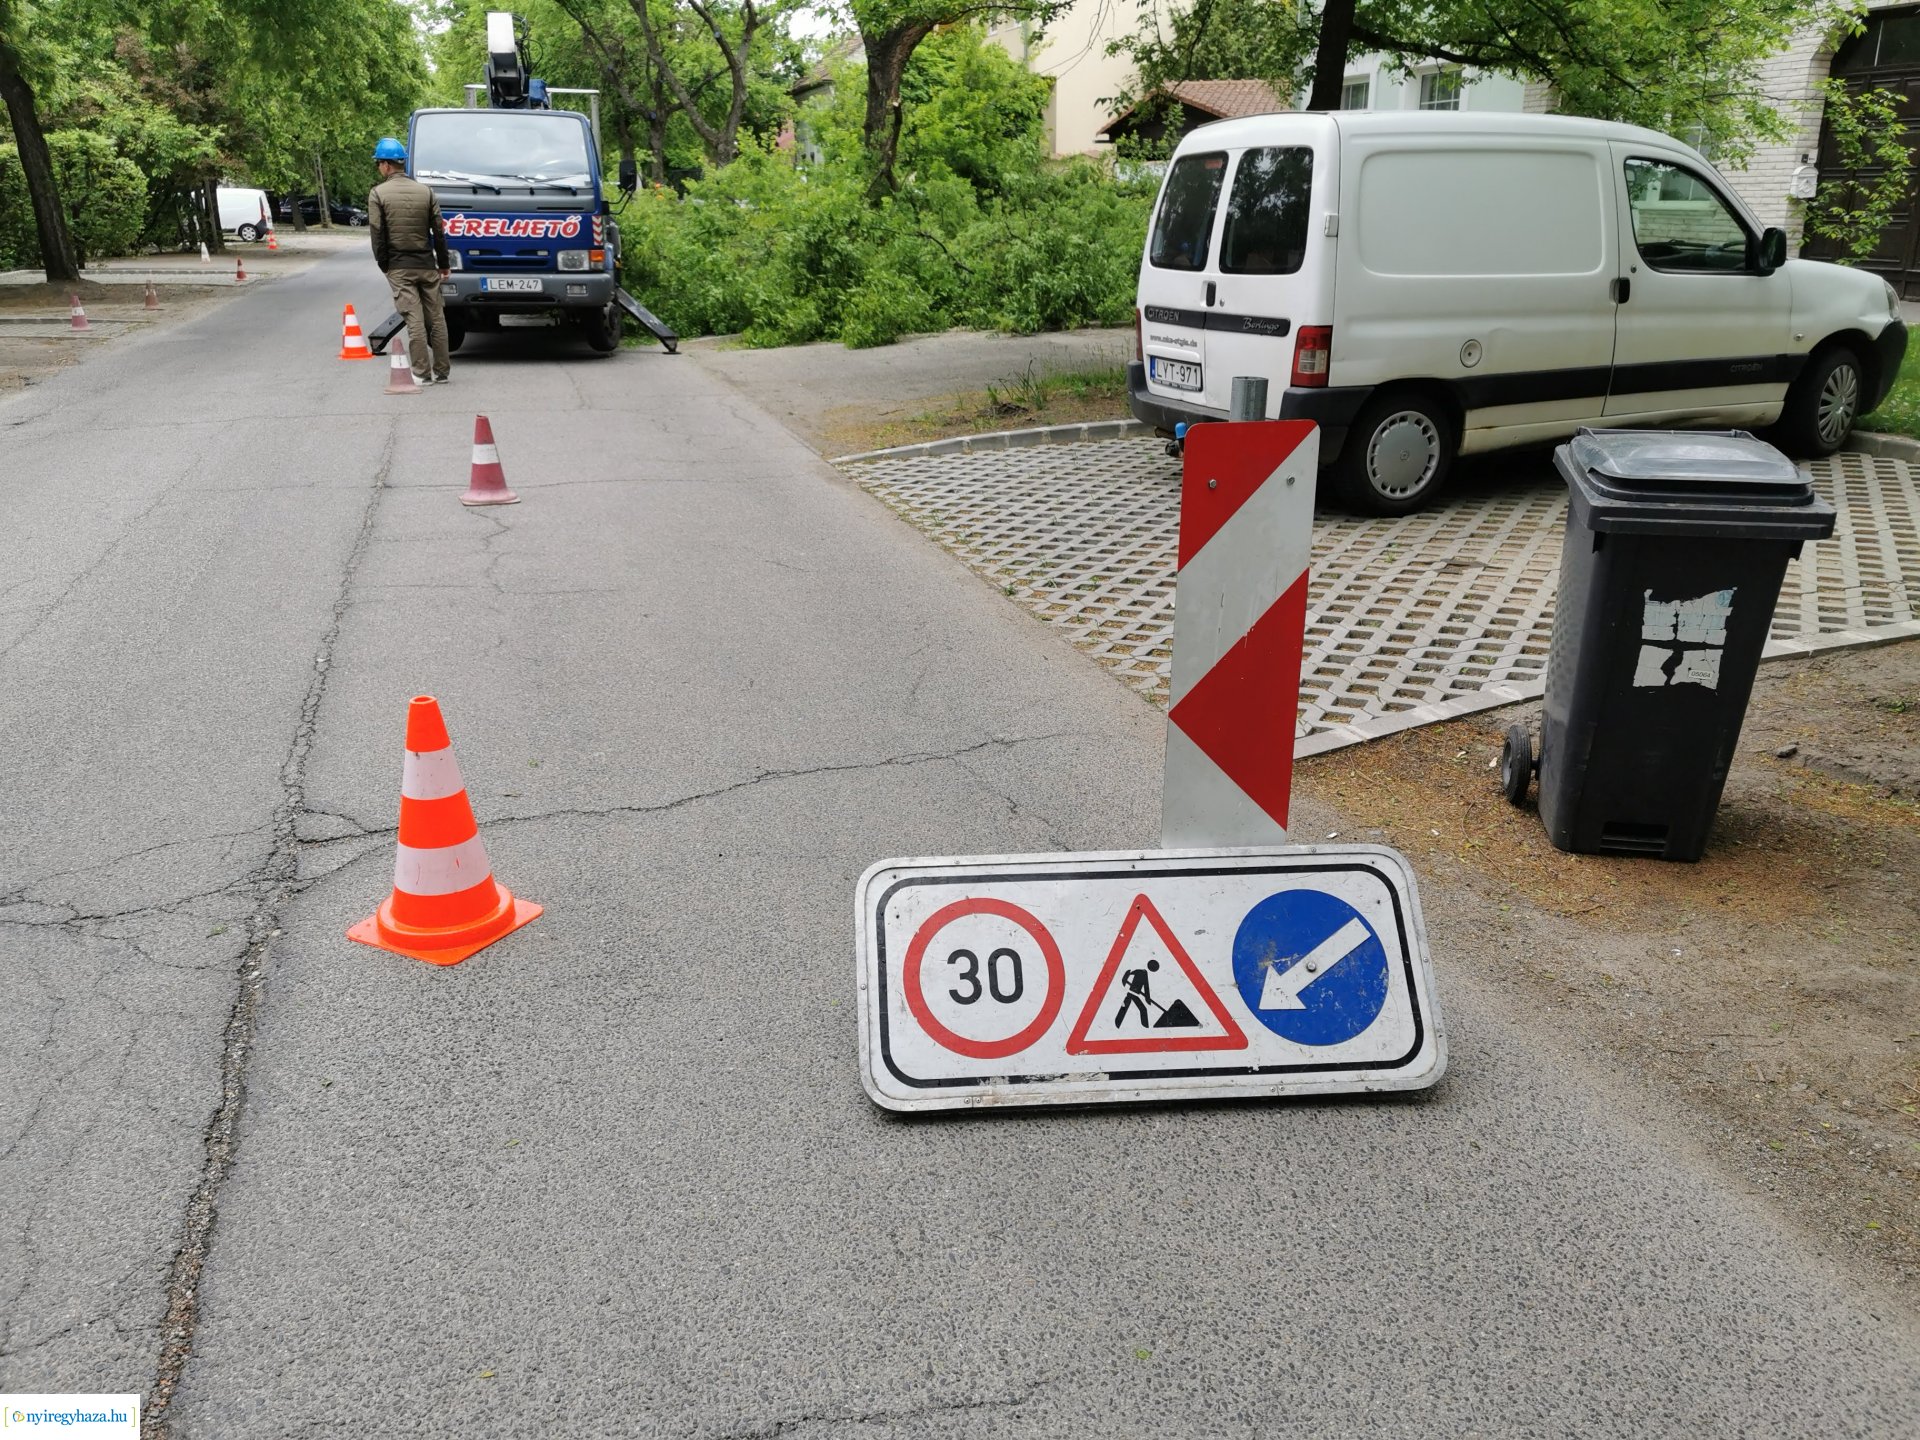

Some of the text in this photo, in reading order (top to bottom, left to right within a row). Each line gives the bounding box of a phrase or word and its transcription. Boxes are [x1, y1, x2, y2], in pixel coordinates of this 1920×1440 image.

[489, 280, 539, 290] LEM-247
[1243, 317, 1280, 333] Berlingo
[1156, 359, 1199, 385] LYT-971
[946, 947, 1024, 1006] 30
